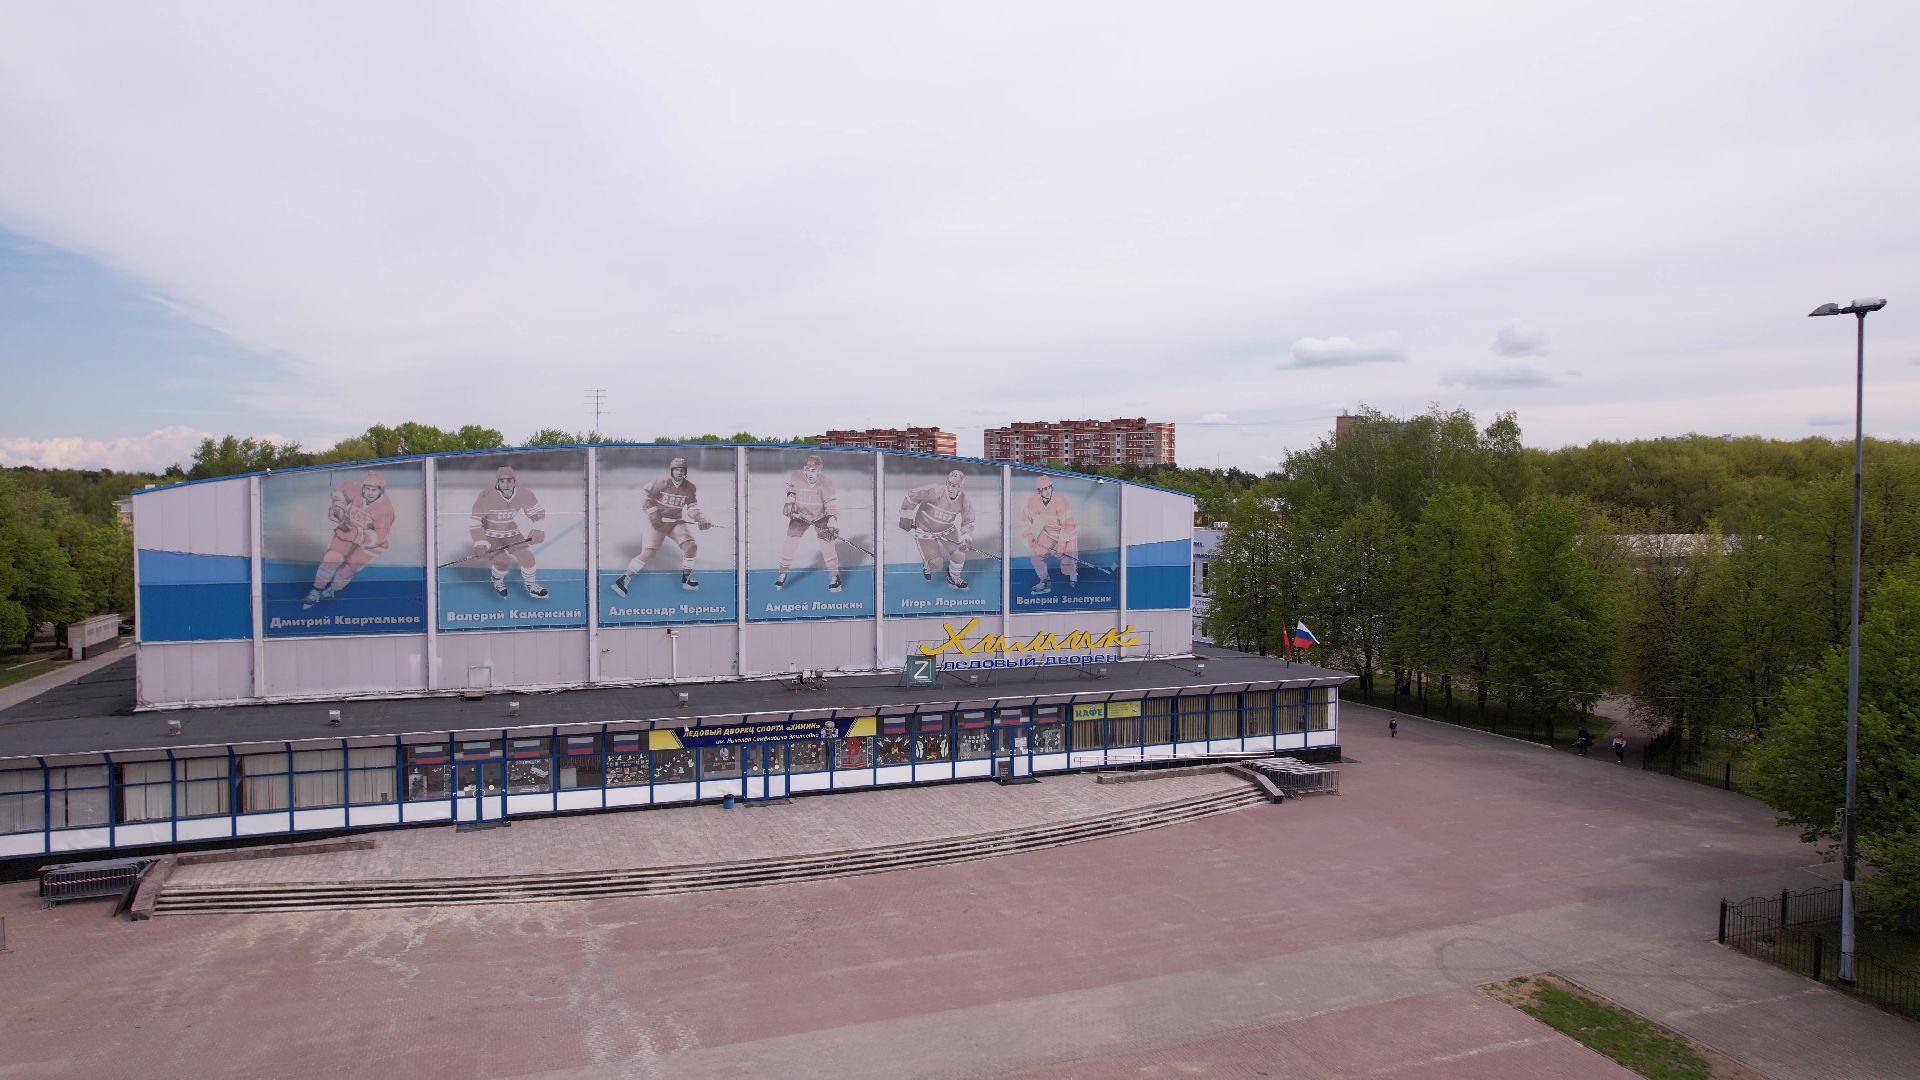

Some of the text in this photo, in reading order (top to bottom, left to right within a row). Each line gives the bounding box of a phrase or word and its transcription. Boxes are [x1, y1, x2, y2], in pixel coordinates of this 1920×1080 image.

[765, 600, 863, 612] Андрей Ломакин
[901, 597, 986, 608] Игорь Ларионов
[1016, 594, 1112, 605] Валерий Зелепукин
[447, 608, 582, 621] Валерий Каменский
[608, 604, 727, 616] Александр Черных
[270, 614, 420, 628] Дмитрий Квартальнов
[919, 617, 1138, 656] Химик
[943, 654, 1119, 670] ледовый дворец
[913, 660, 929, 679] Z
[1075, 708, 1103, 718] КАФЕ
[683, 727, 722, 738] ЛЕДОВЫЙ
[723, 726, 755, 736] ДВОРЕЦ
[756, 724, 784, 733] СПОРТА
